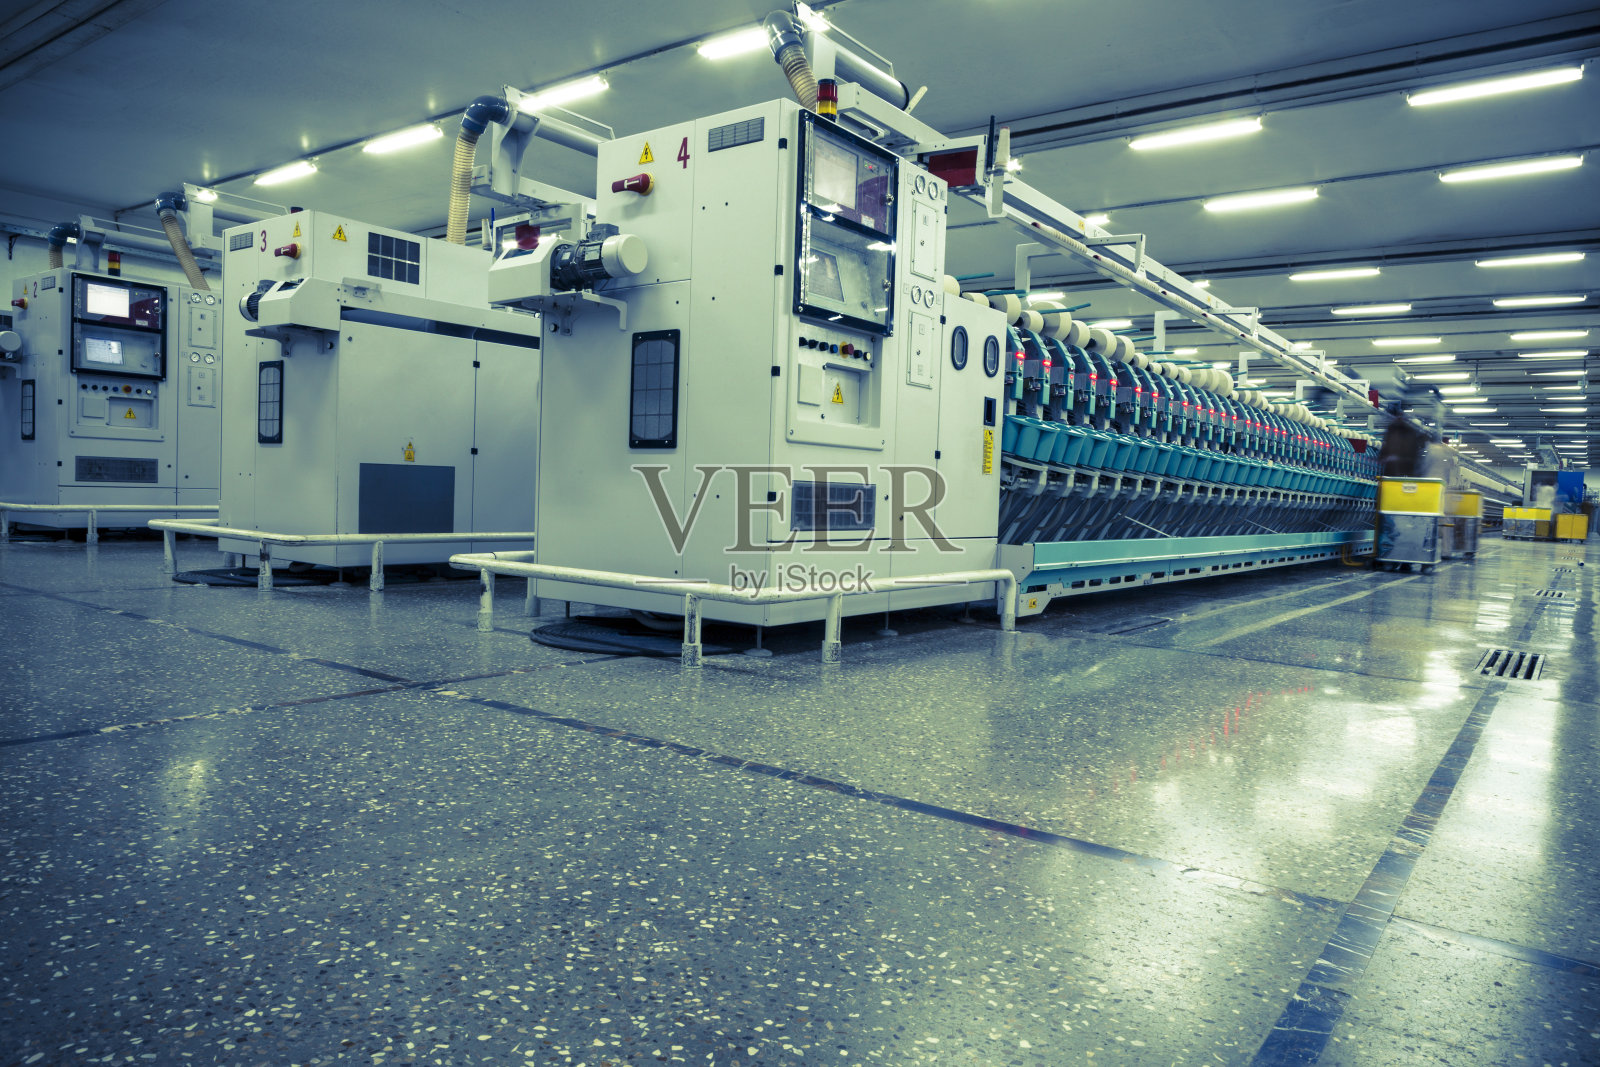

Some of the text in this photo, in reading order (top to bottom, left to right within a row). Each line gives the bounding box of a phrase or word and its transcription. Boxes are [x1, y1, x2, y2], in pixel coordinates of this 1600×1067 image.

[677, 136, 690, 169] 4
[260, 229, 267, 252] 3
[33, 281, 38, 298] 2
